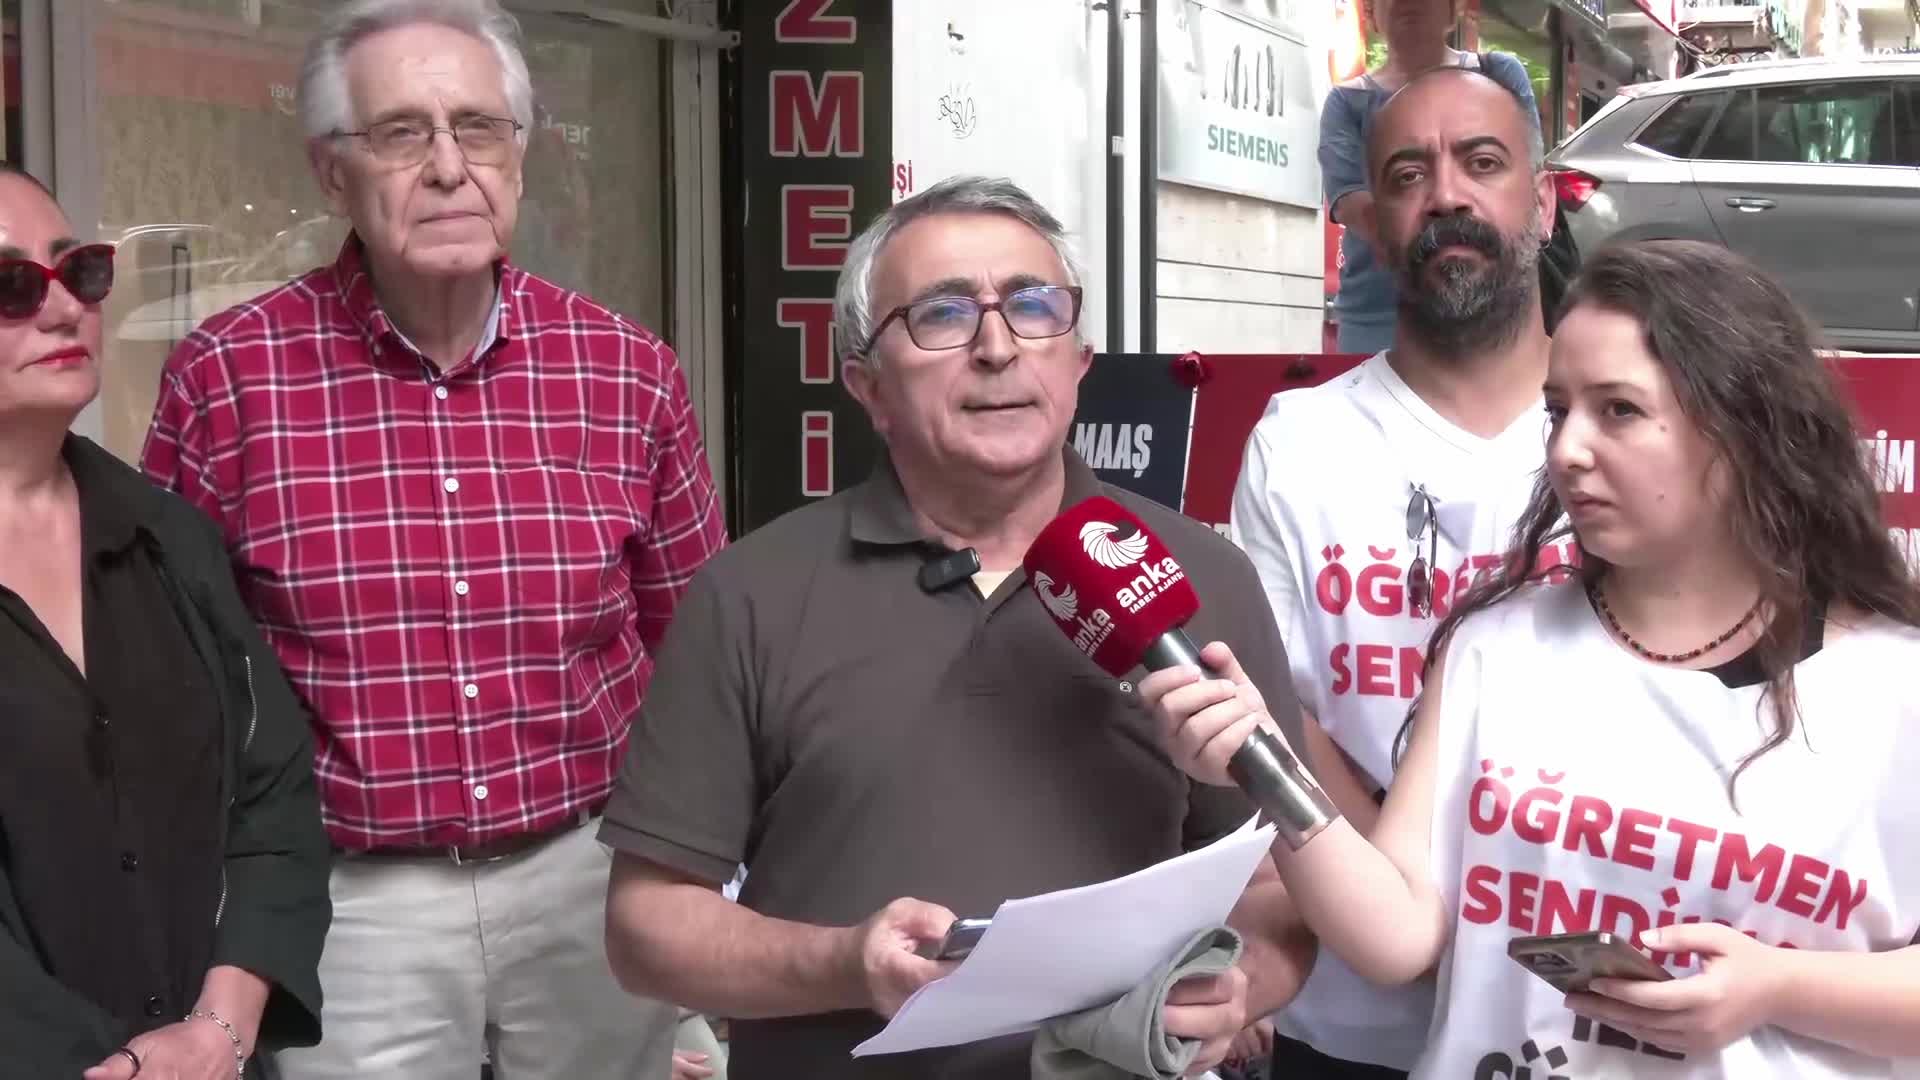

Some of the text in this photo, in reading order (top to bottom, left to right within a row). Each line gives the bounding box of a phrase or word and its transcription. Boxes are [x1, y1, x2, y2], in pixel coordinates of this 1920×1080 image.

[1207, 123, 1289, 168] SIEMENS
[1074, 422, 1153, 478] MAAŞ
[1116, 556, 1180, 608] anka
[1073, 608, 1111, 651] anka
[1468, 759, 1868, 930] ÖĞRETMEN
